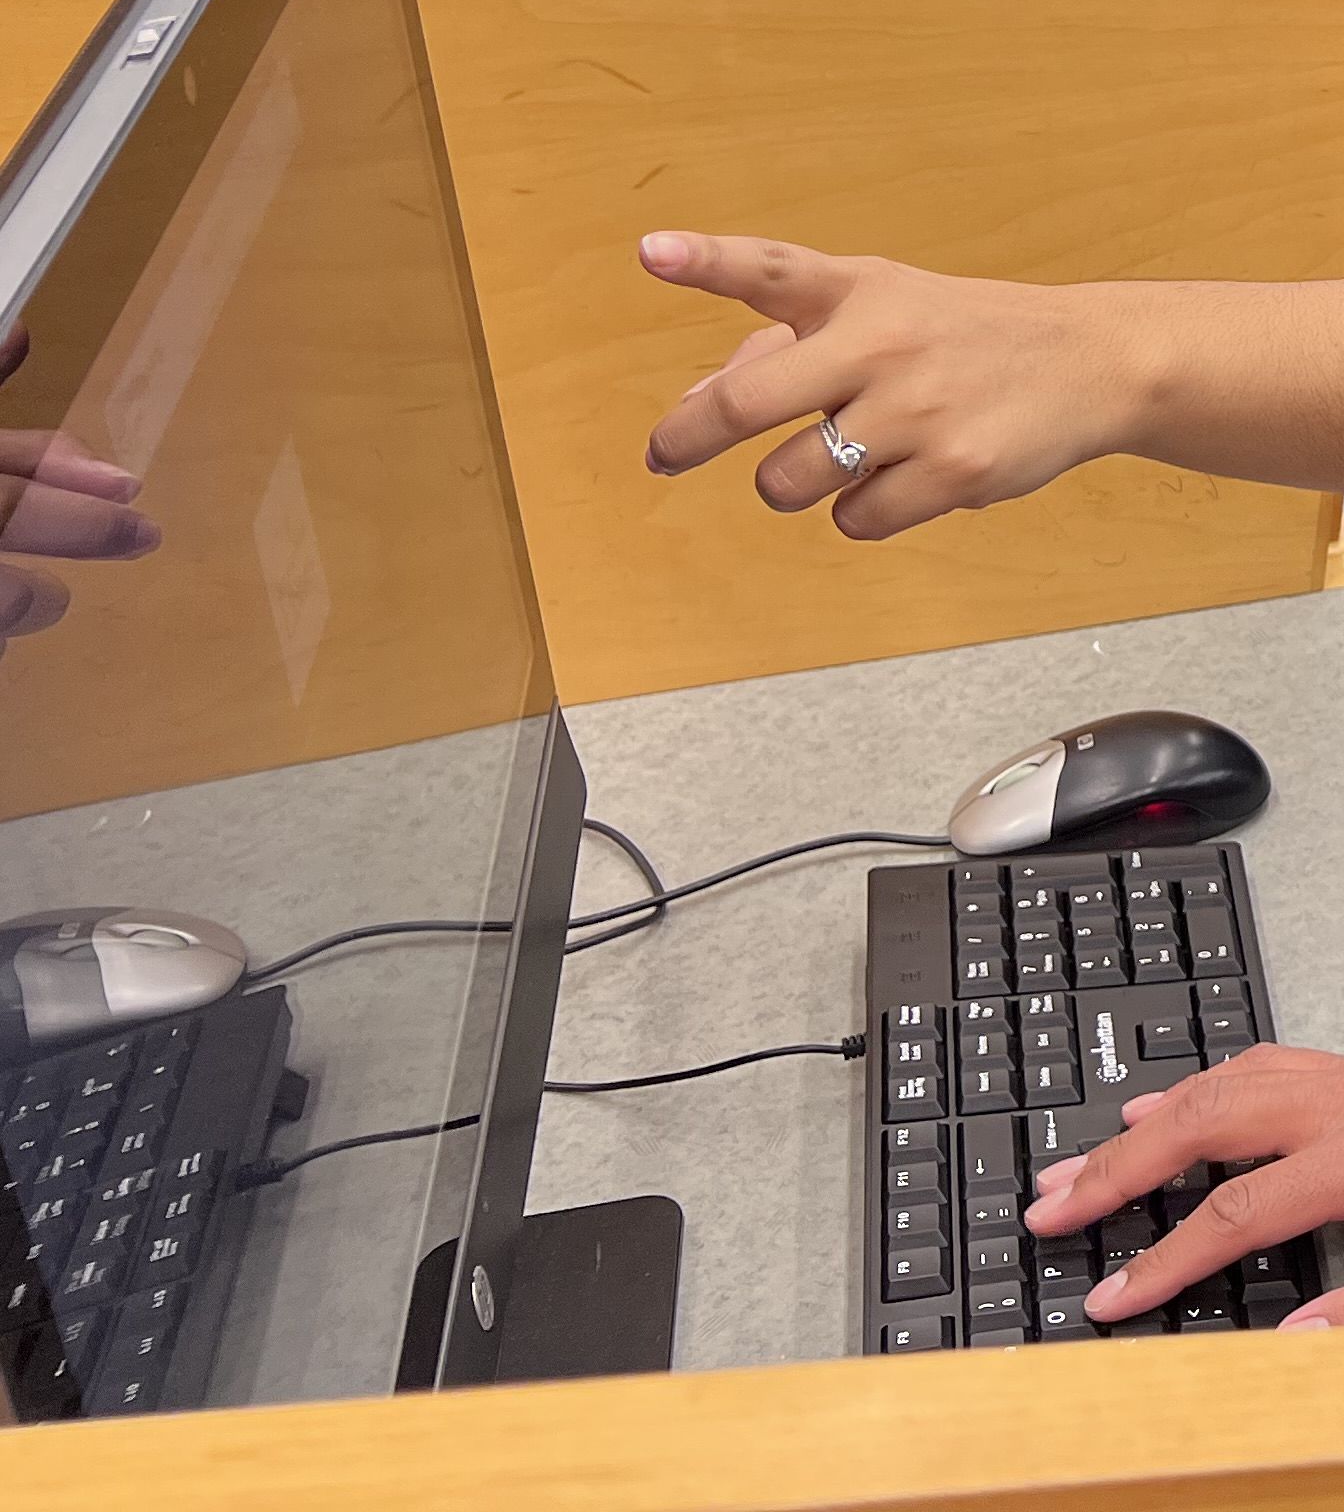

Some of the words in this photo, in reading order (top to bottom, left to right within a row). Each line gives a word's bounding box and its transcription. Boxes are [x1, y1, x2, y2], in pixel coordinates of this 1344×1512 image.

[1076, 927, 1092, 936] 5
[1134, 923, 1149, 931] 2
[1022, 965, 1037, 974] 7
[1080, 961, 1094, 969] 4
[1090, 1012, 1119, 1078] manhattan
[897, 1128, 909, 1145] F12
[1045, 1127, 1059, 1149] Enter
[897, 1171, 909, 1187] F11
[897, 1211, 910, 1229] F10
[897, 1261, 910, 1274] F9
[1043, 1267, 1062, 1278] P
[1047, 1311, 1066, 1324] O
